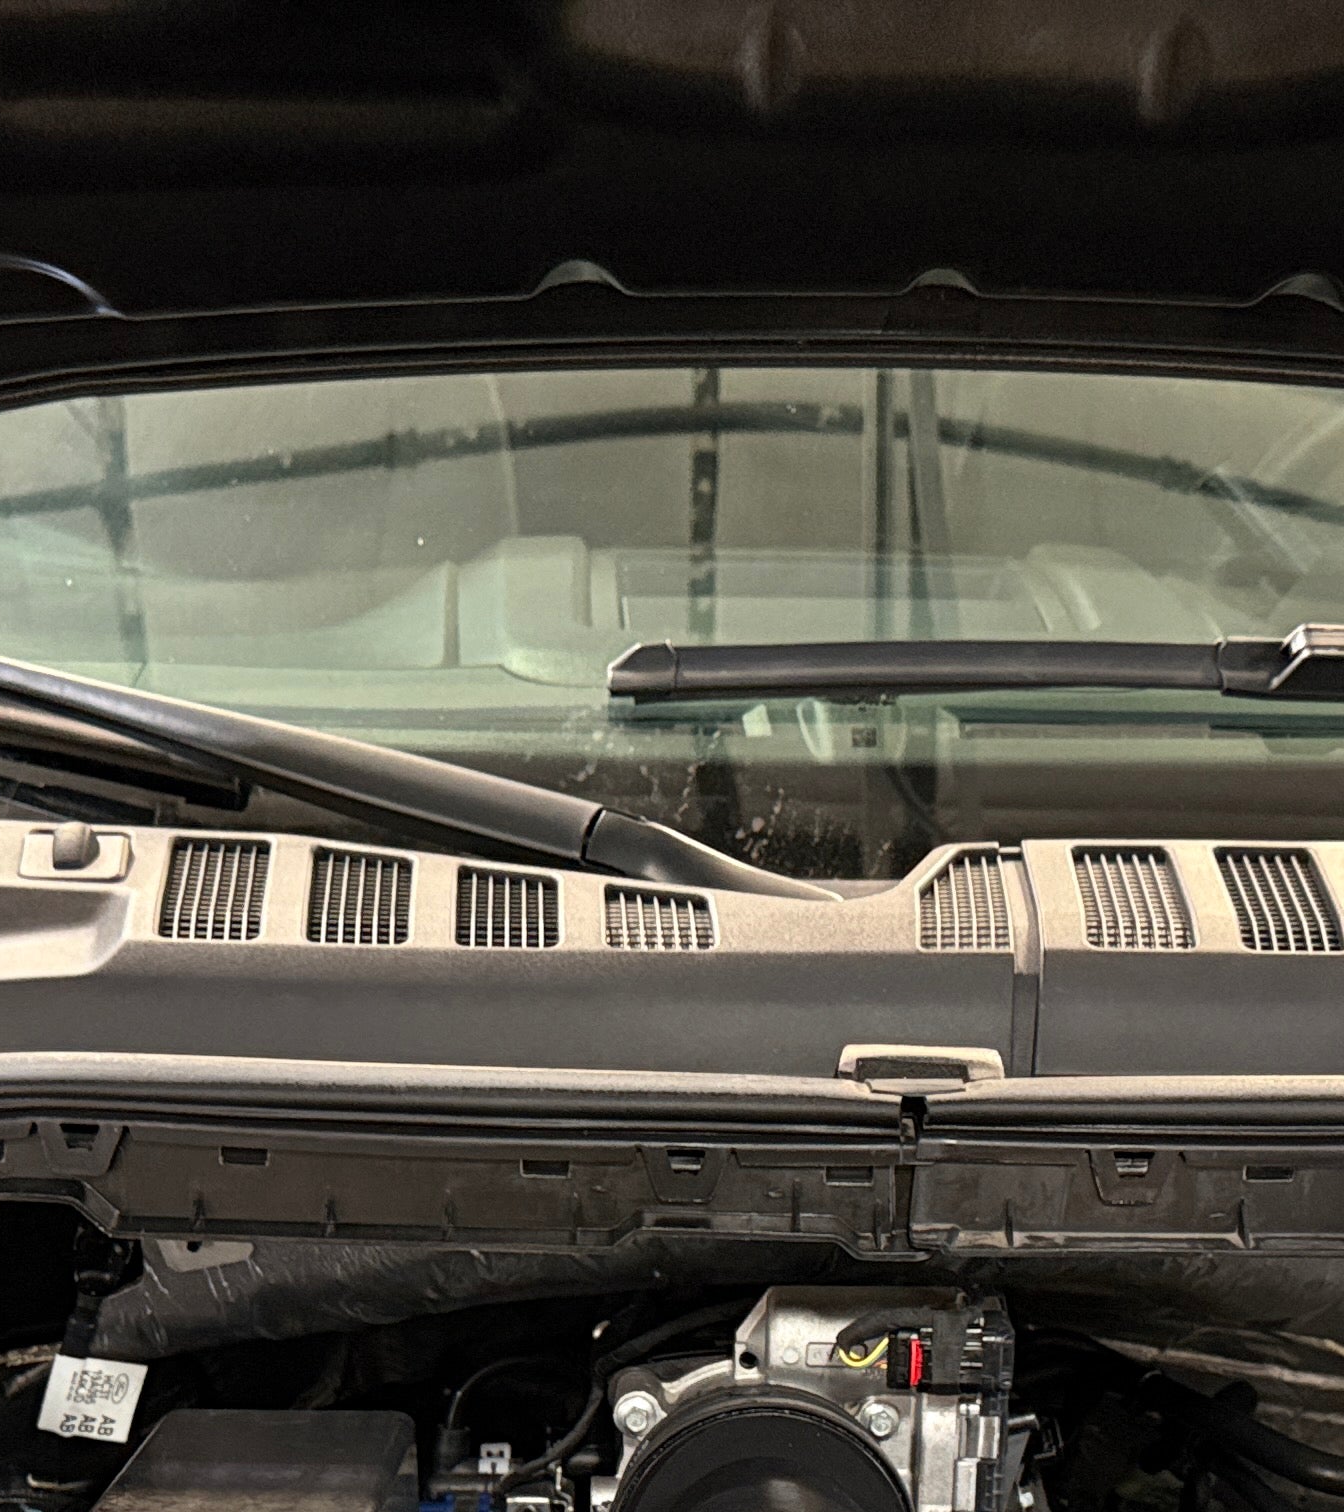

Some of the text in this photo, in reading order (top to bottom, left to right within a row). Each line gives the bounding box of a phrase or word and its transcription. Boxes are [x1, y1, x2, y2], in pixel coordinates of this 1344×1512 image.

[59, 1413, 78, 1433] AB
[78, 1414, 97, 1433] AB
[97, 1414, 116, 1436] AB
